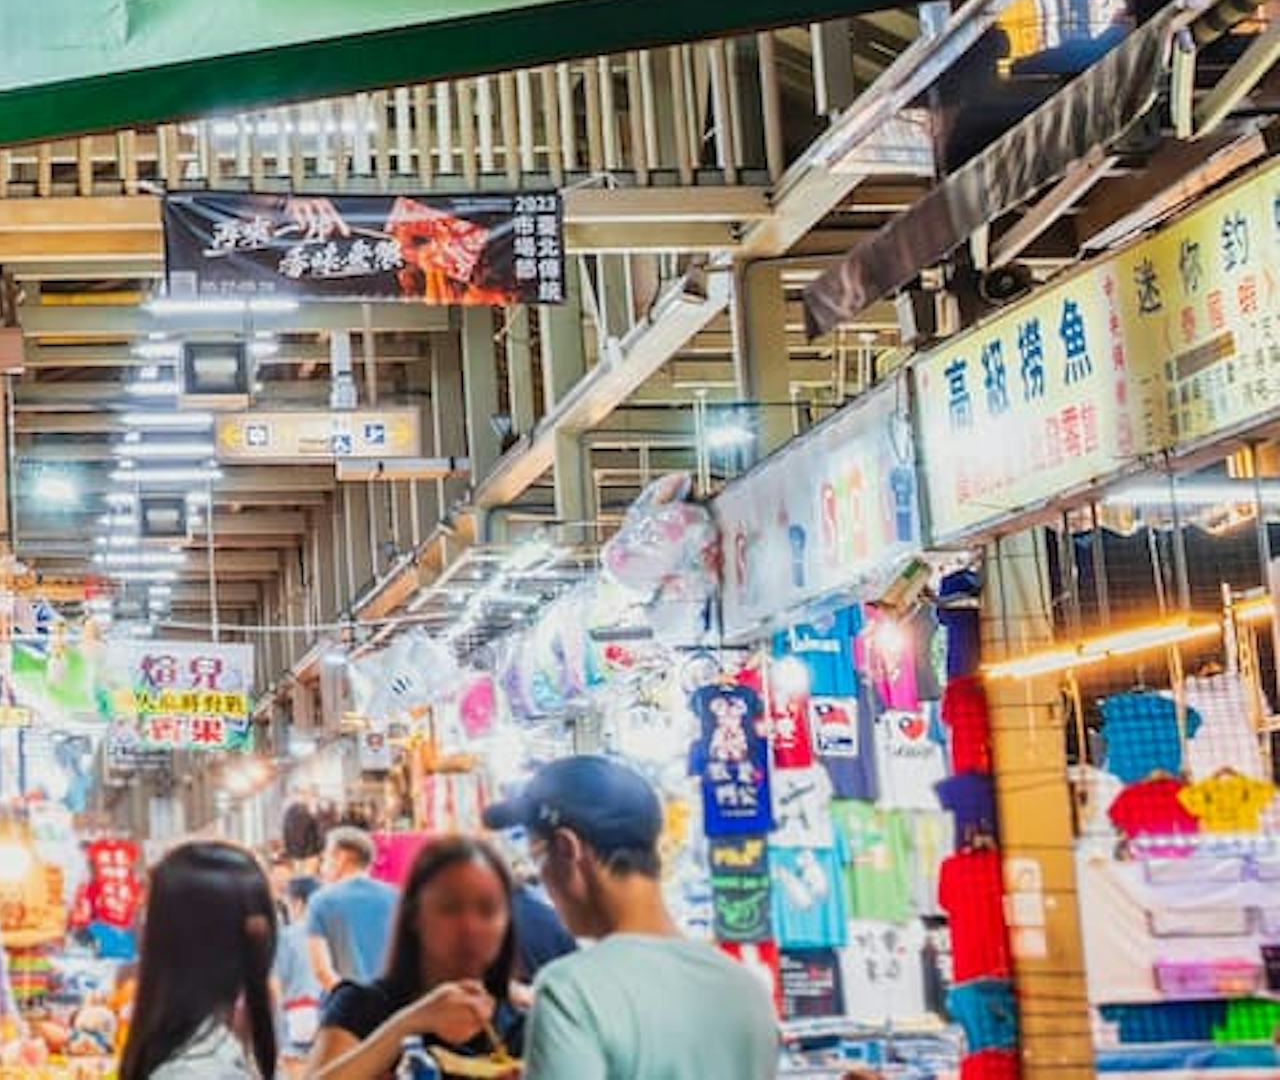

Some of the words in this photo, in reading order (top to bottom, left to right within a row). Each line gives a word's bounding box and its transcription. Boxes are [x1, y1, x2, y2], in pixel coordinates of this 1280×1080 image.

[1132, 196, 1280, 316] 迷你釣
[943, 296, 1094, 434] 高級撈魚
